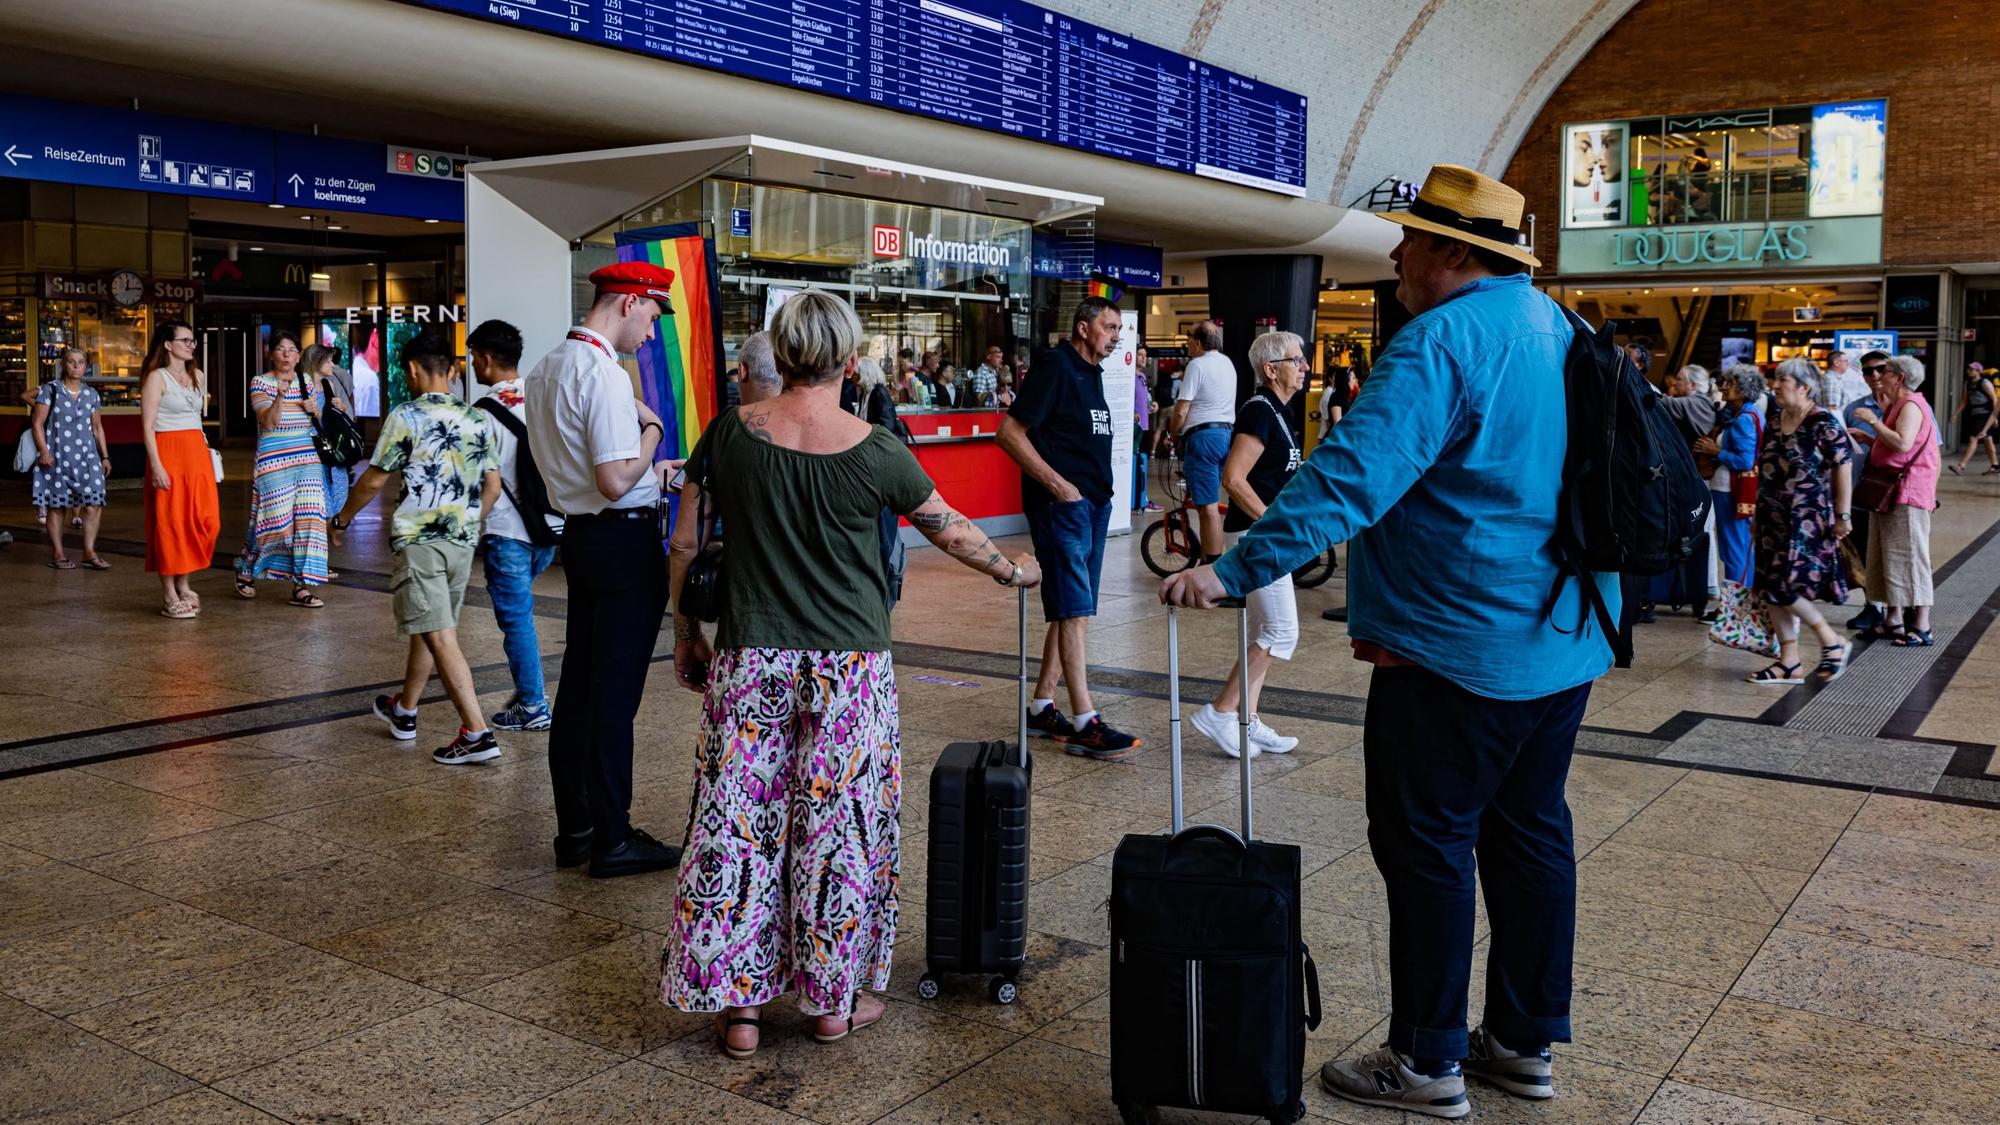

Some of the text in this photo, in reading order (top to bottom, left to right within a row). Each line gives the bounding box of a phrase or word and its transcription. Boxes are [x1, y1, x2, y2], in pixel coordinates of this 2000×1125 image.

[489, 3, 520, 20] Au (Sieg)
[570, 5, 578, 15] 11
[605, 0, 622, 10] 12:51
[605, 13, 622, 25] 12:54
[570, 22, 579, 32] 10
[605, 30, 622, 42] 12:54
[45, 146, 126, 166] ReiseZentrum
[417, 155, 430, 173] S
[437, 162, 448, 170] Bus
[314, 177, 375, 192] zu den Zügen
[314, 190, 366, 204] koelnmesse
[877, 231, 1010, 267] DB Information
[1616, 224, 1808, 266] DOUGLAS
[52, 277, 194, 299] Snack Stop
[346, 304, 466, 323] ETERN
[1090, 410, 1109, 422] EHF
